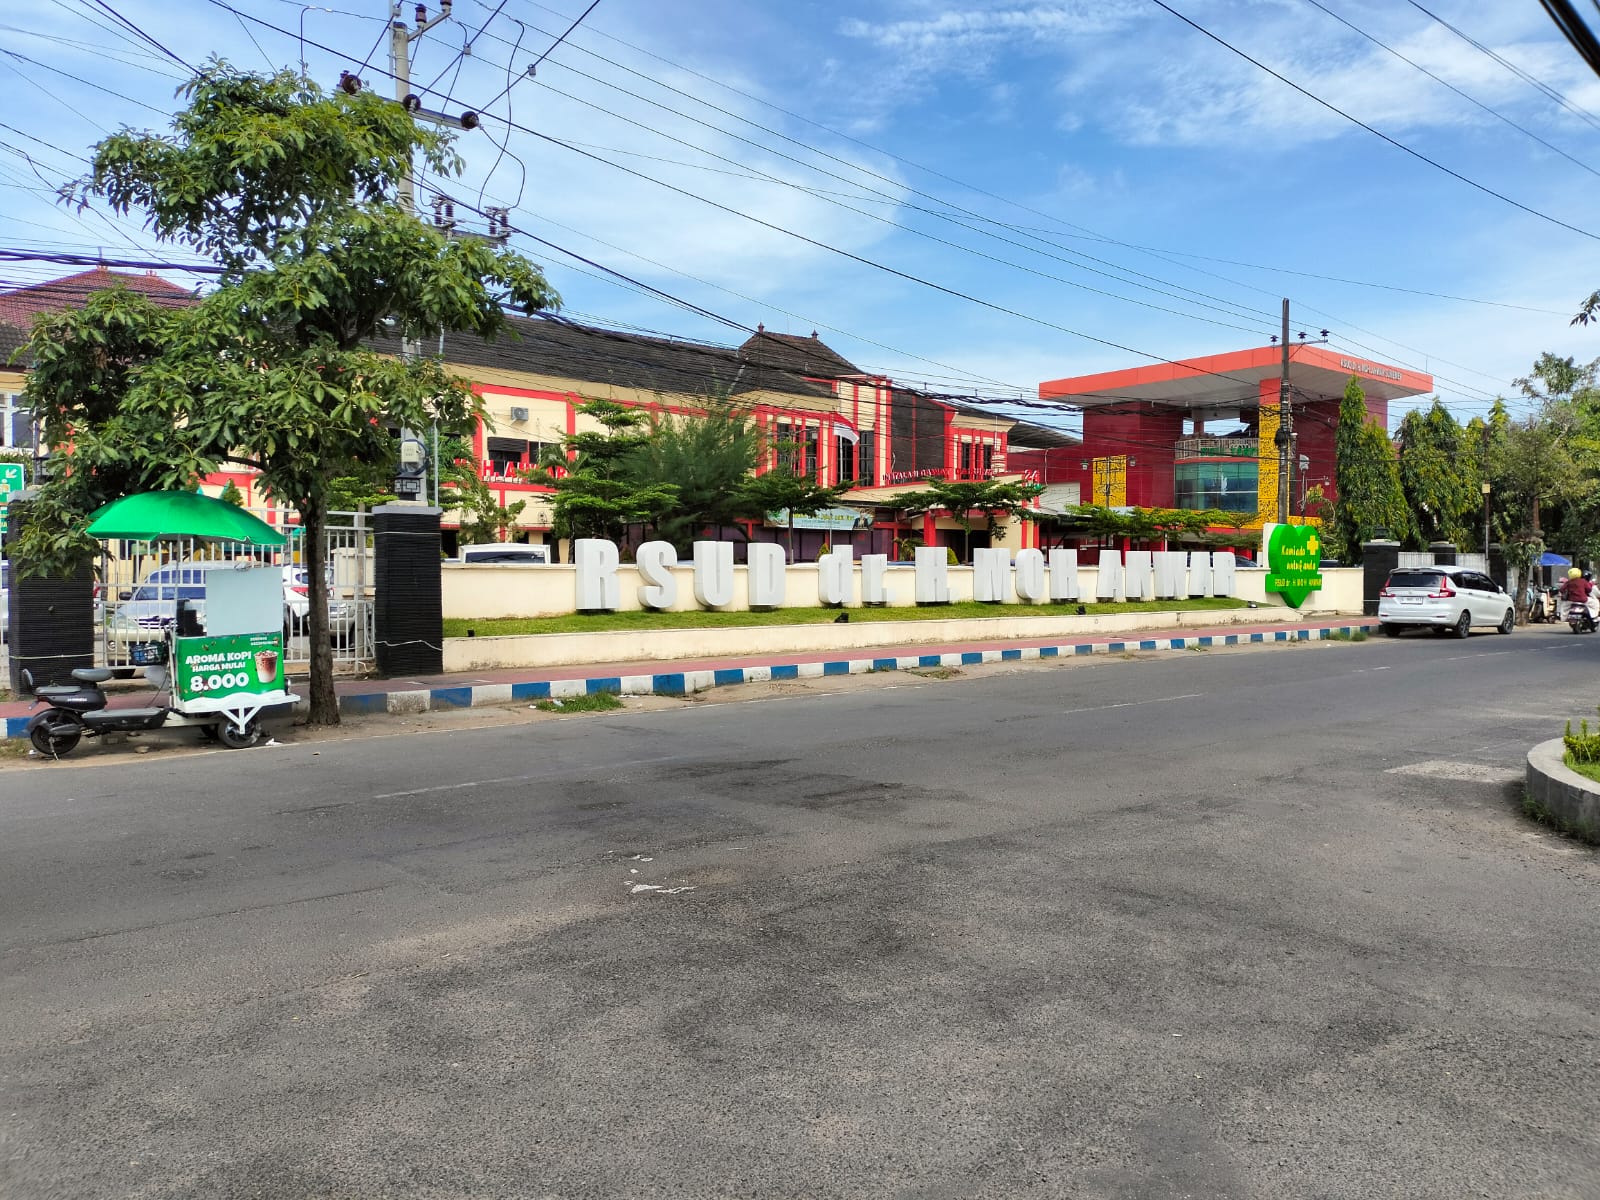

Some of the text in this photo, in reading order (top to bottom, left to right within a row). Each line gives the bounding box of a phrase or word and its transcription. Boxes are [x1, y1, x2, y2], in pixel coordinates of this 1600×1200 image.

[575, 538, 786, 609] RSUD
[1096, 549, 1236, 600] ANWAR
[185, 651, 252, 664] AROMA KOPI
[192, 662, 245, 672] HARGA MULAI
[190, 672, 249, 692] 8.000
